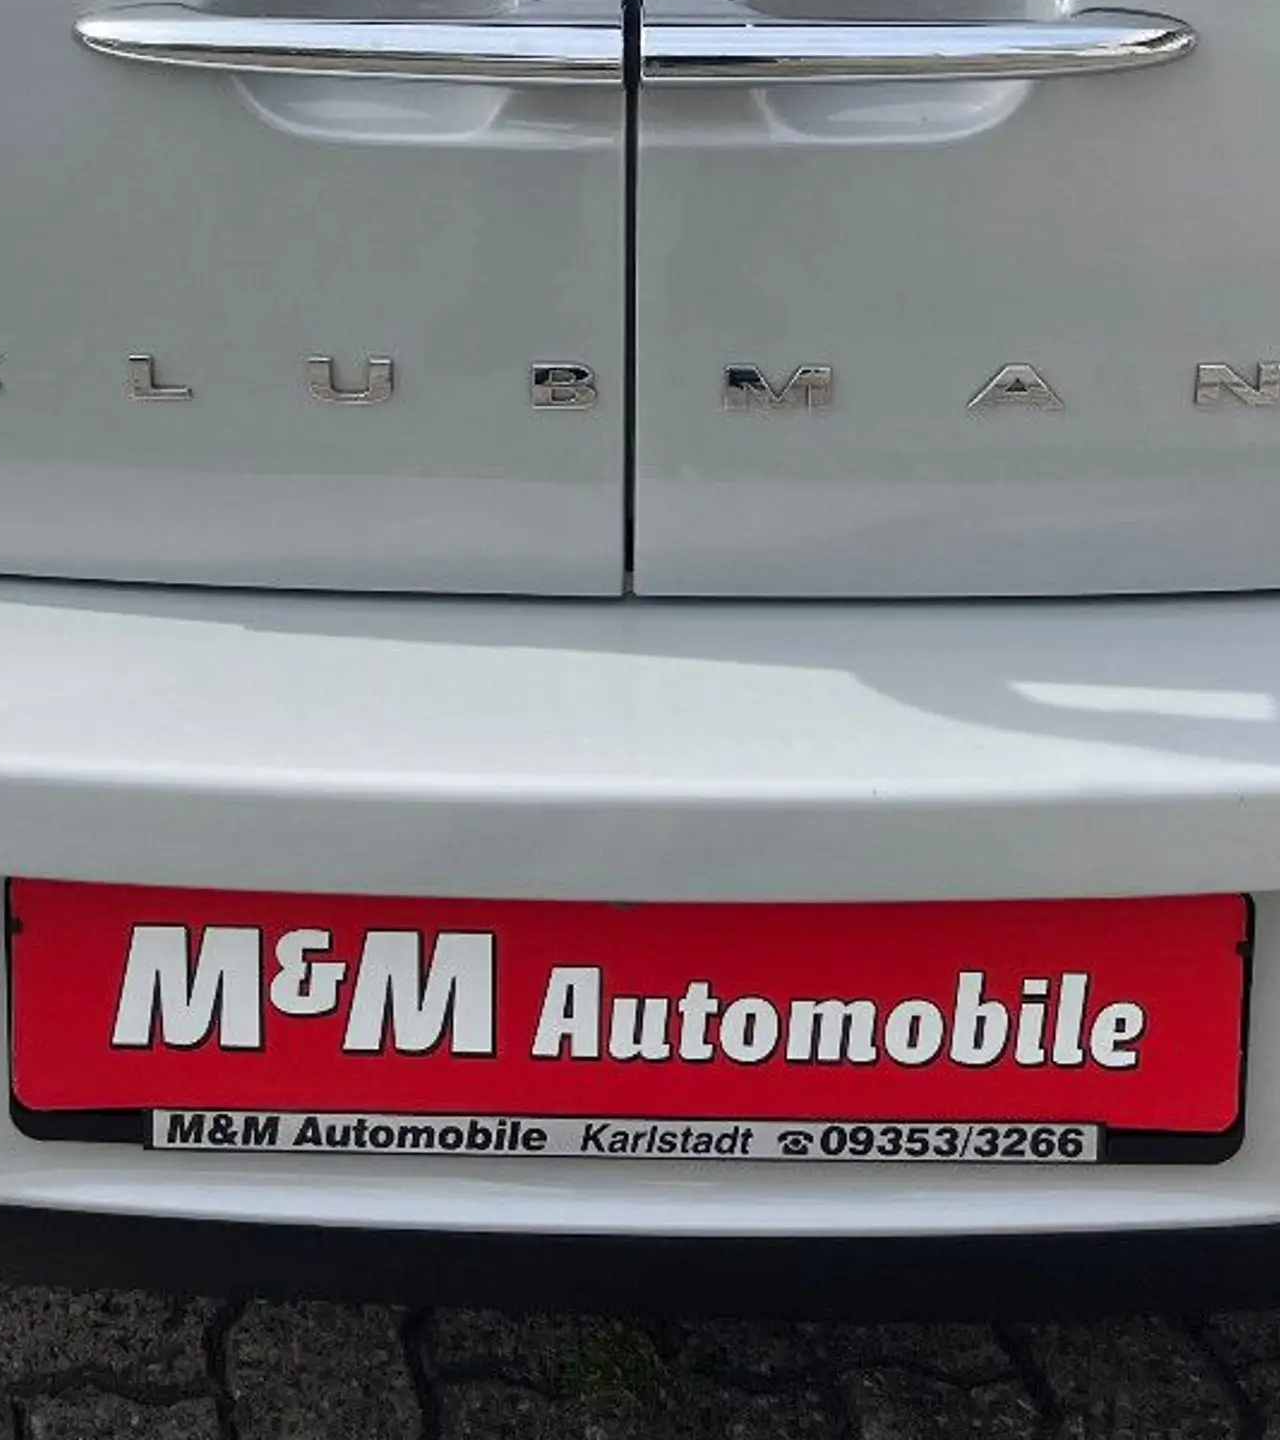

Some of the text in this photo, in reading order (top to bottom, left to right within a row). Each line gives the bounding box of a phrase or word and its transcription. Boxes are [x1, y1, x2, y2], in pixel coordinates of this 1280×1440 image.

[110, 923, 1146, 1068] M&M Automobile
[166, 1113, 1085, 1159] M&M Automobile Karlstadt 09353/3266
